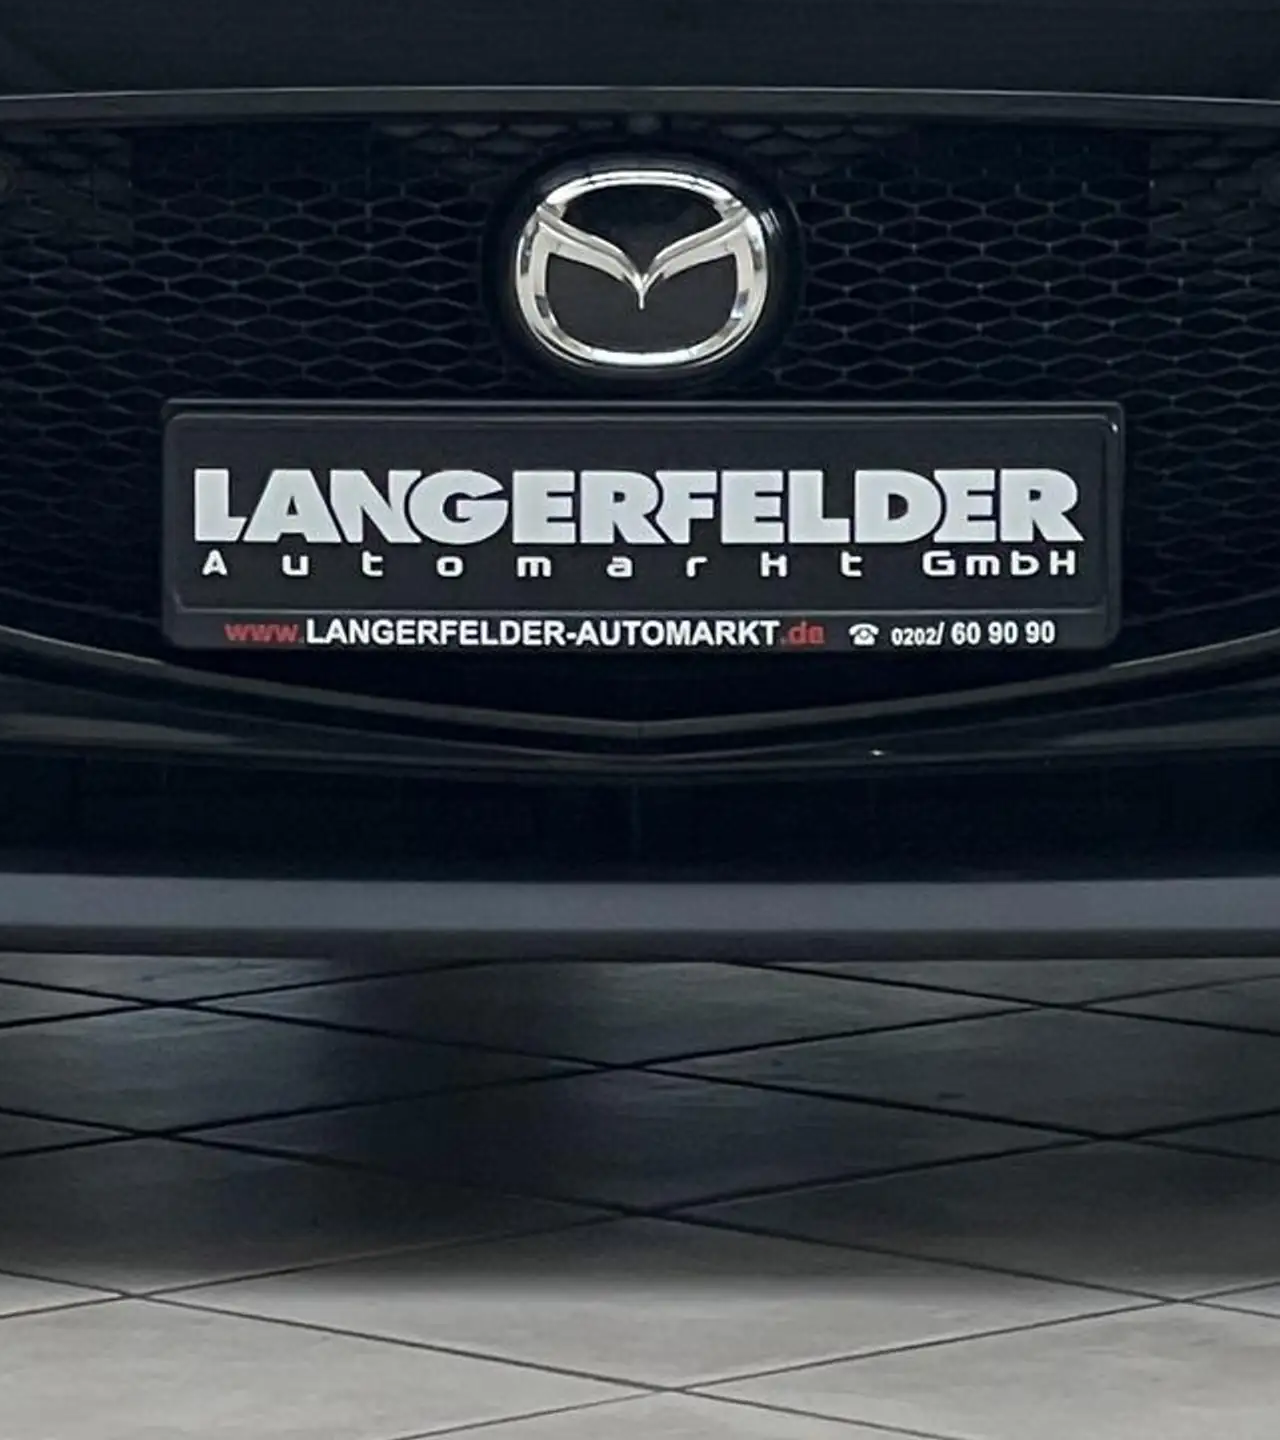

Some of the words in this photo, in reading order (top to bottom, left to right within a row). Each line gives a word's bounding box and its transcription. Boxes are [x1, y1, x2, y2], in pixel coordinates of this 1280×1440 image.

[193, 467, 1085, 545] LANGERFELDER
[922, 548, 1077, 578] GmbH
[224, 618, 825, 647] www.LANGERFELDER-AUTOMARKT.de
[950, 620, 982, 646] 60
[988, 620, 1019, 646] 90
[1024, 619, 1056, 645] 90
